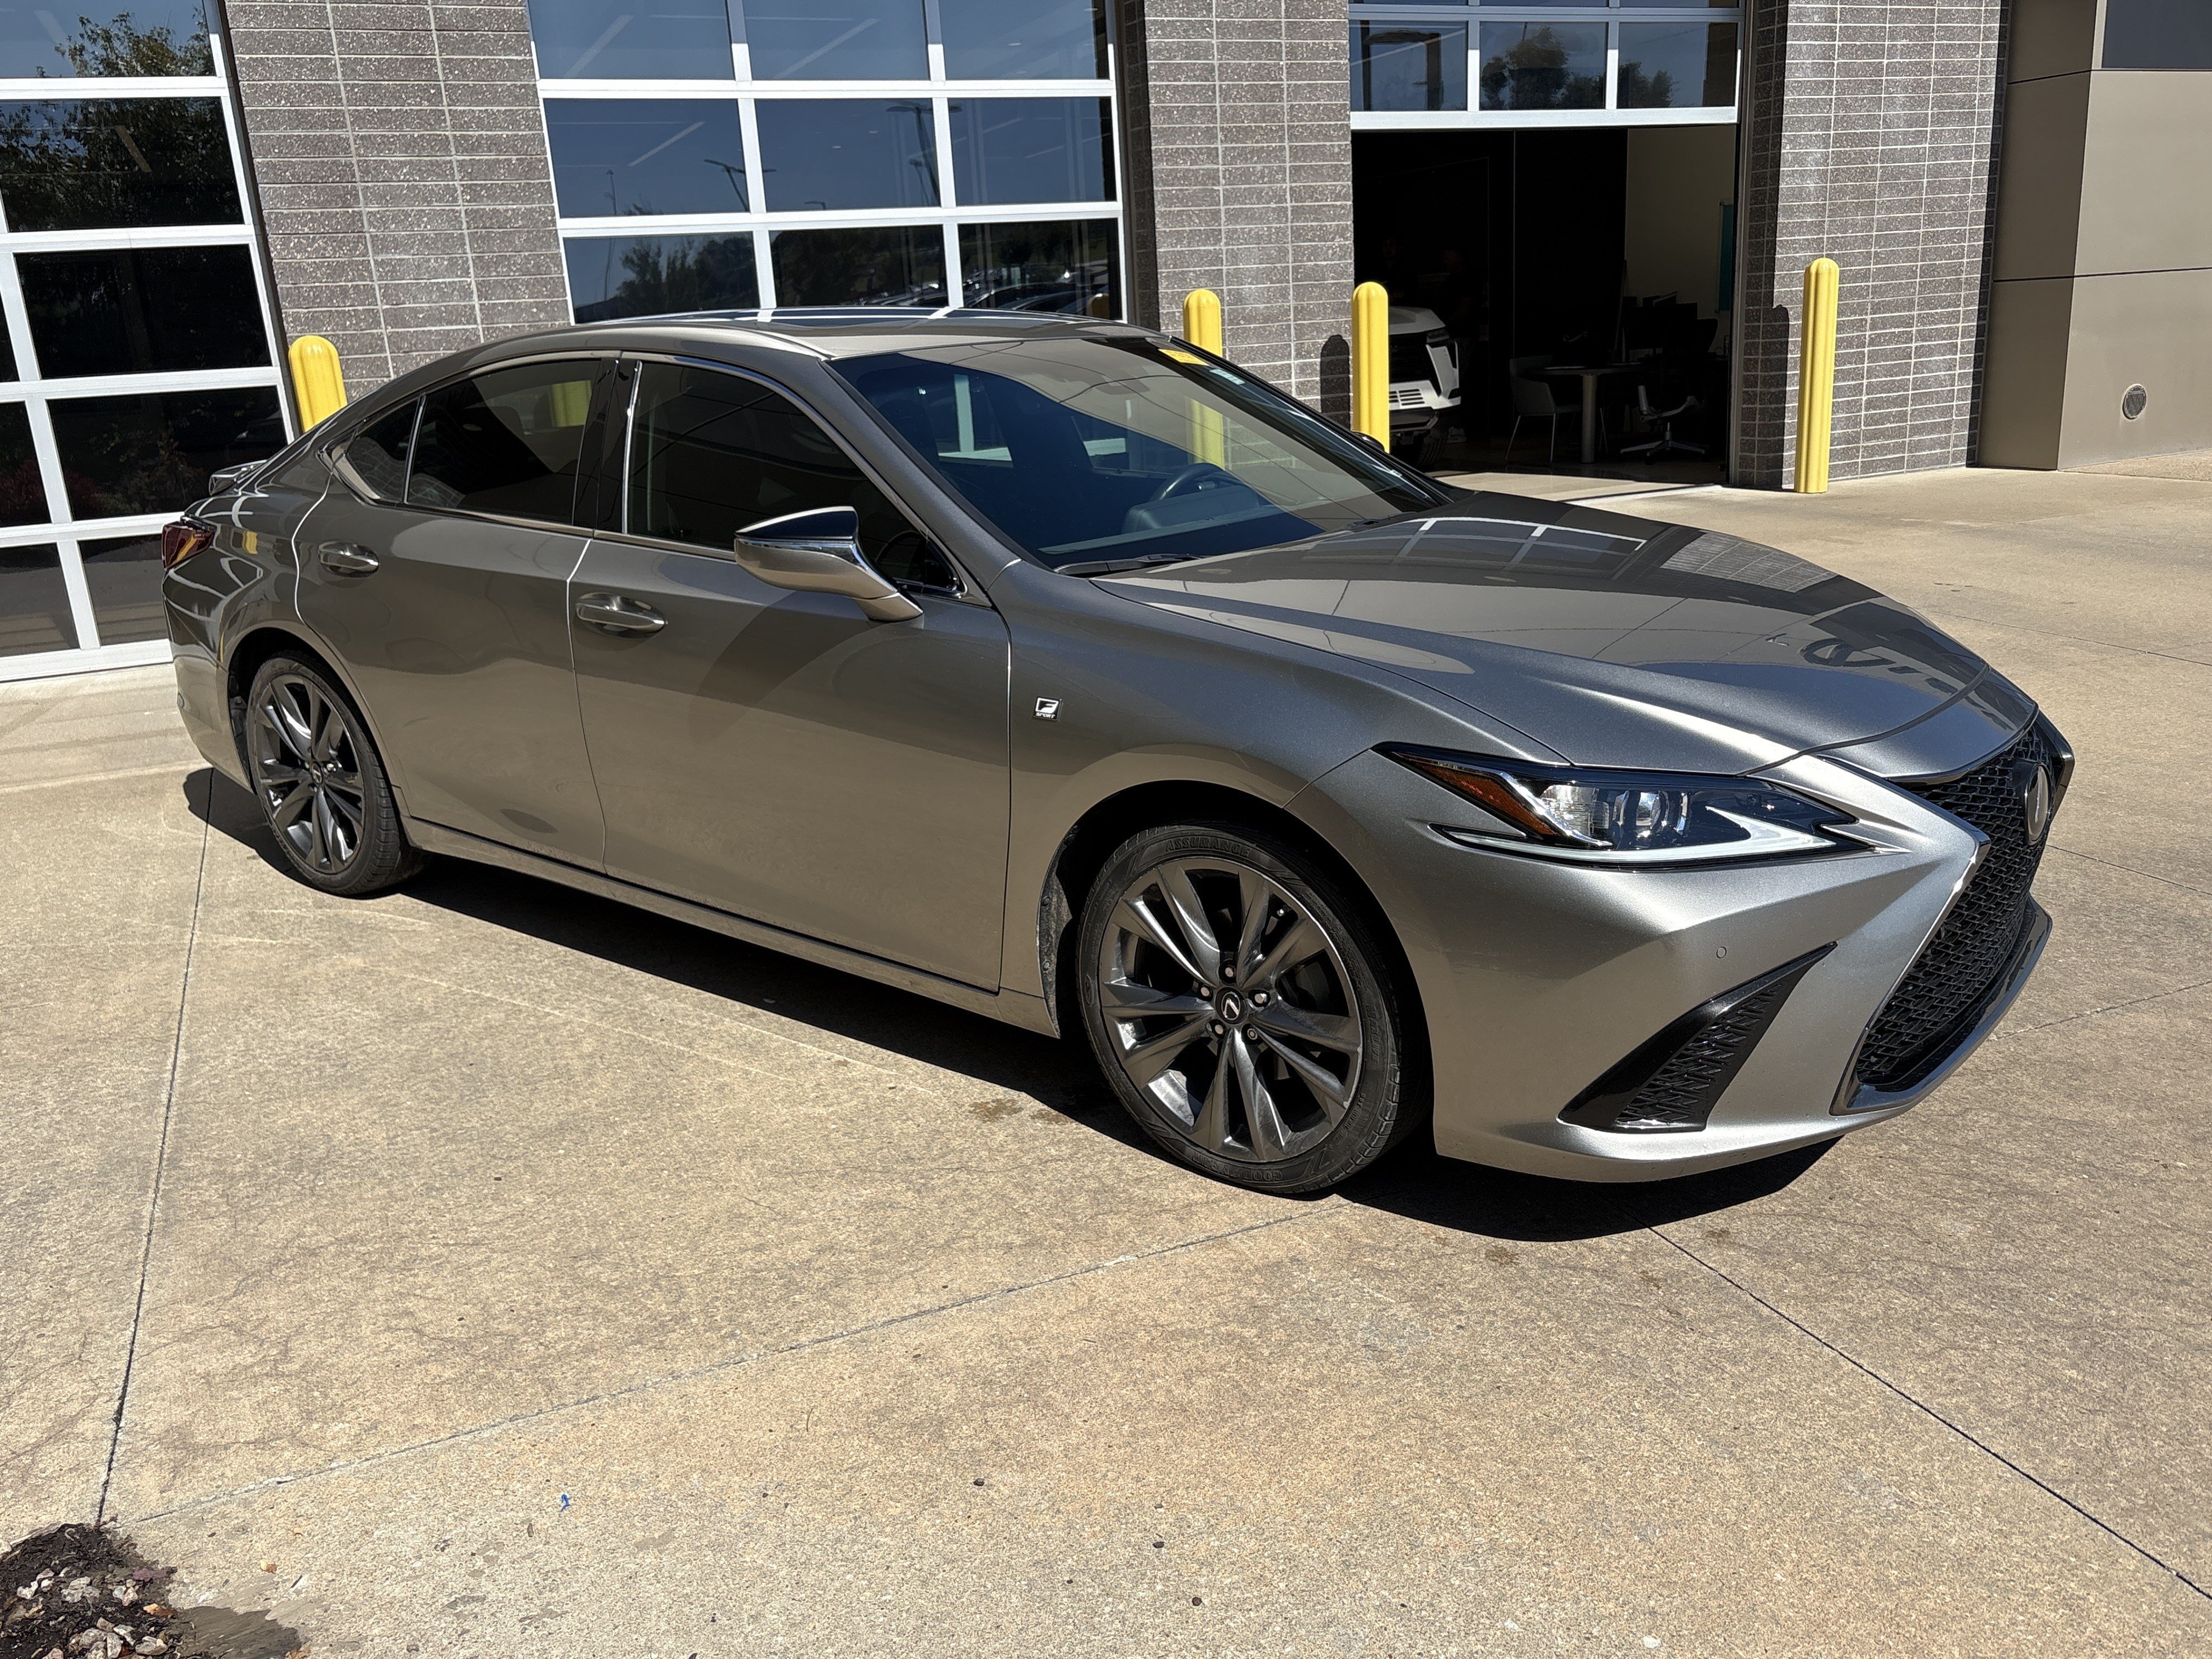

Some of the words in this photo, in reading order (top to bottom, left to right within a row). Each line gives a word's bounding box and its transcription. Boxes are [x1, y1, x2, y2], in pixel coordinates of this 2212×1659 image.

[1165, 837, 1251, 857] ASSURANCE
[1364, 1003, 1380, 1064] MAXLIFE
[1192, 1151, 1283, 1181] GOODYEAR
